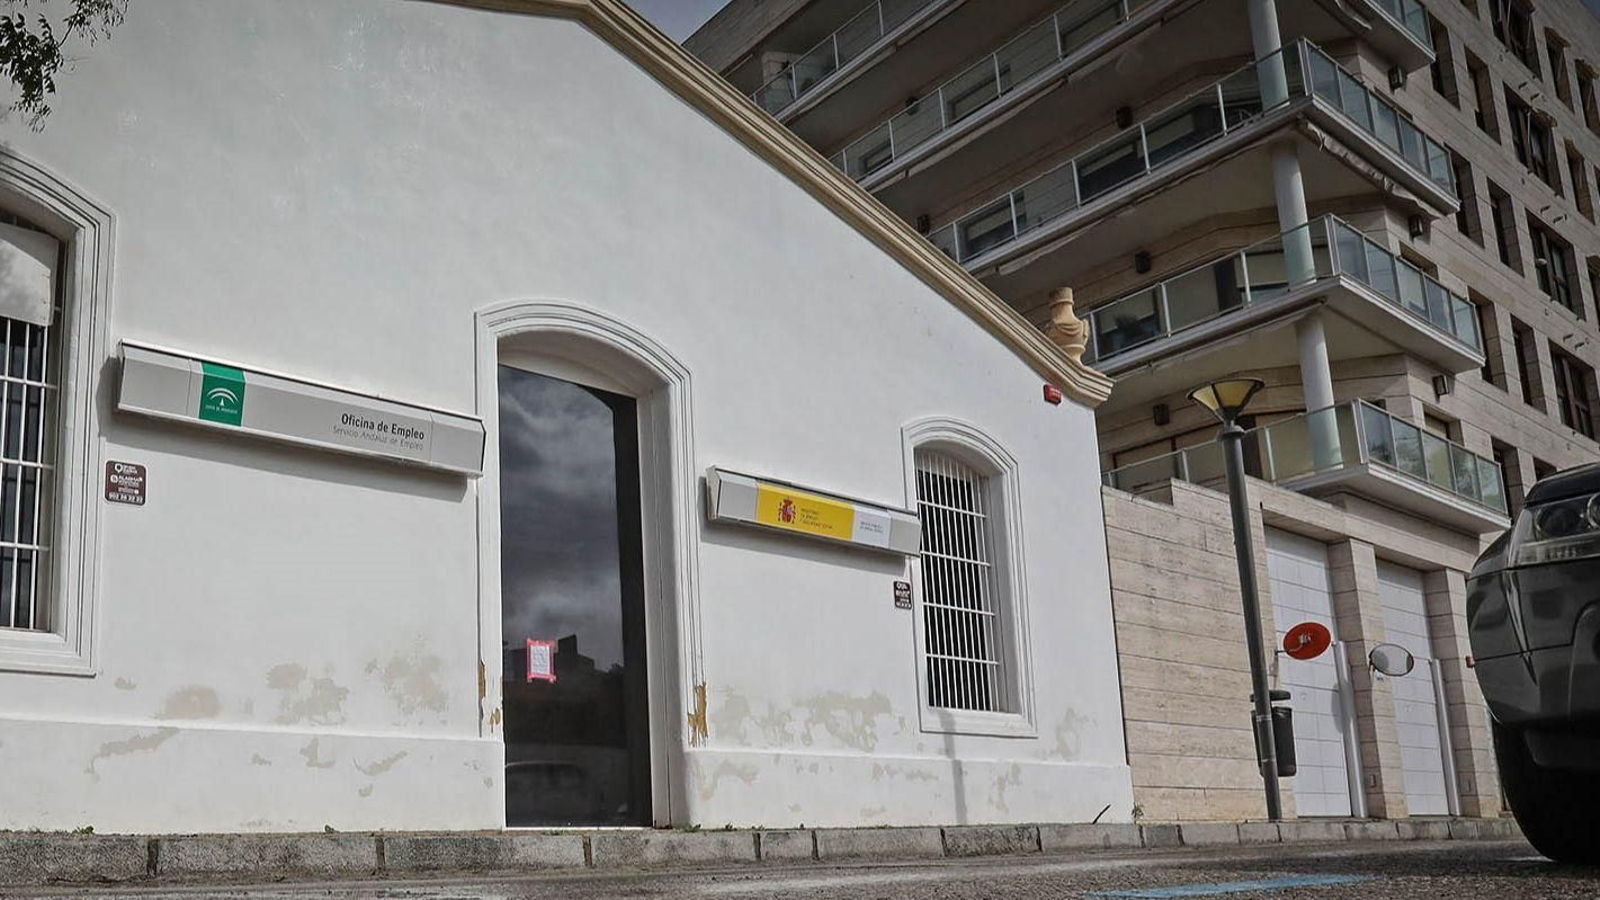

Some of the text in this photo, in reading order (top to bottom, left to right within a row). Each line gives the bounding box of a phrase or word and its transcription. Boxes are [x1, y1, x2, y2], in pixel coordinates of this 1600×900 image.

[333, 425, 358, 438] Servicio
[400, 439, 424, 451] Empleo
[341, 413, 424, 440] Oficina de Empleo
